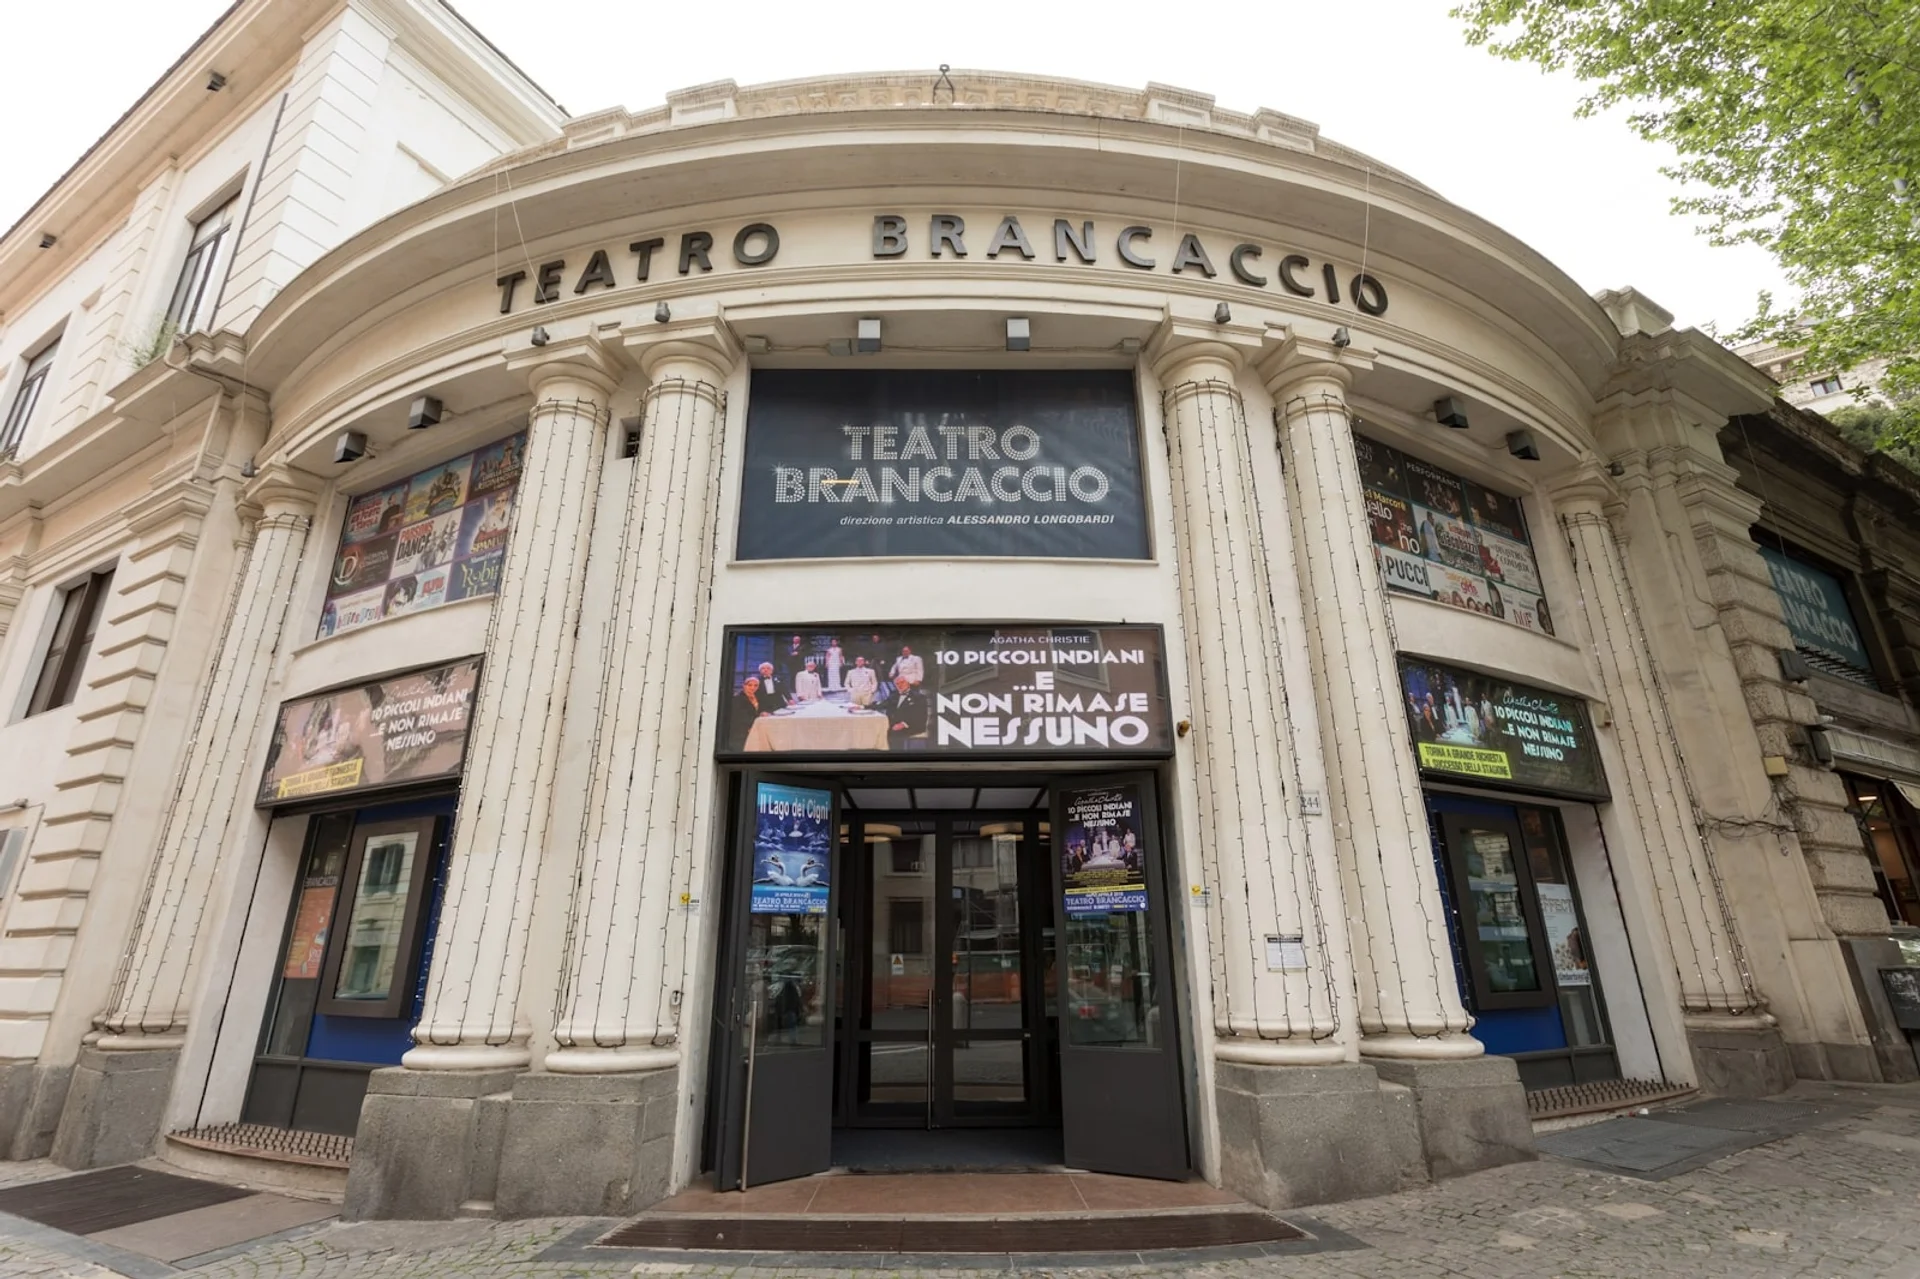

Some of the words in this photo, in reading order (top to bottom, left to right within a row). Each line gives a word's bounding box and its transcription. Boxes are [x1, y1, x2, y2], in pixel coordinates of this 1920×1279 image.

[497, 222, 780, 314] TEATRO
[873, 213, 1389, 317] BRANCACCIO
[843, 424, 1041, 461] TEATRO
[775, 465, 1110, 503] BRANCACCIO
[1406, 461, 1461, 490] PERFORMANCE
[840, 515, 893, 526] direzione
[896, 514, 944, 525] artistica
[947, 515, 1030, 525] ALESSANDRO
[1033, 514, 1114, 525] LONGOBARDI
[396, 532, 431, 561] DANCE
[1397, 529, 1420, 554] ho
[1770, 561, 1828, 611] EATRO
[989, 635, 1035, 644] AGATHA
[1038, 635, 1090, 644] CHRISTIE
[935, 650, 960, 665] 10
[964, 650, 1046, 665] PICCOLI
[1052, 649, 1144, 664] INDIANI
[1013, 671, 1055, 691] ...E
[371, 707, 382, 721] 10
[383, 698, 422, 719] PICCOLI
[422, 688, 468, 710] INDIANI
[936, 692, 1012, 715] NON
[1023, 692, 1149, 713] RIMASE
[388, 716, 415, 734] NON
[418, 706, 463, 728] RIMASE
[1494, 705, 1505, 719] 10
[1505, 707, 1538, 725] PICCOLI
[1539, 714, 1574, 733] INDIANI
[386, 729, 436, 752] NESSUNO
[937, 715, 1149, 749] NESSUNO
[1516, 724, 1541, 741] NON
[1541, 730, 1577, 748] RIMASE
[1522, 741, 1564, 761] NESSUNO
[760, 793, 766, 814] Il
[768, 795, 790, 821] Lago
[792, 797, 805, 817] dei
[806, 799, 828, 825] Cigni
[1076, 804, 1102, 813] PICCOLI
[1103, 801, 1133, 811] INDIANI
[1082, 812, 1100, 820] NON
[753, 897, 780, 905] TEATRO
[783, 897, 828, 905] BRANCACCIO
[1066, 897, 1094, 905] TEATRO
[1096, 895, 1145, 904] BRANCACCIO
